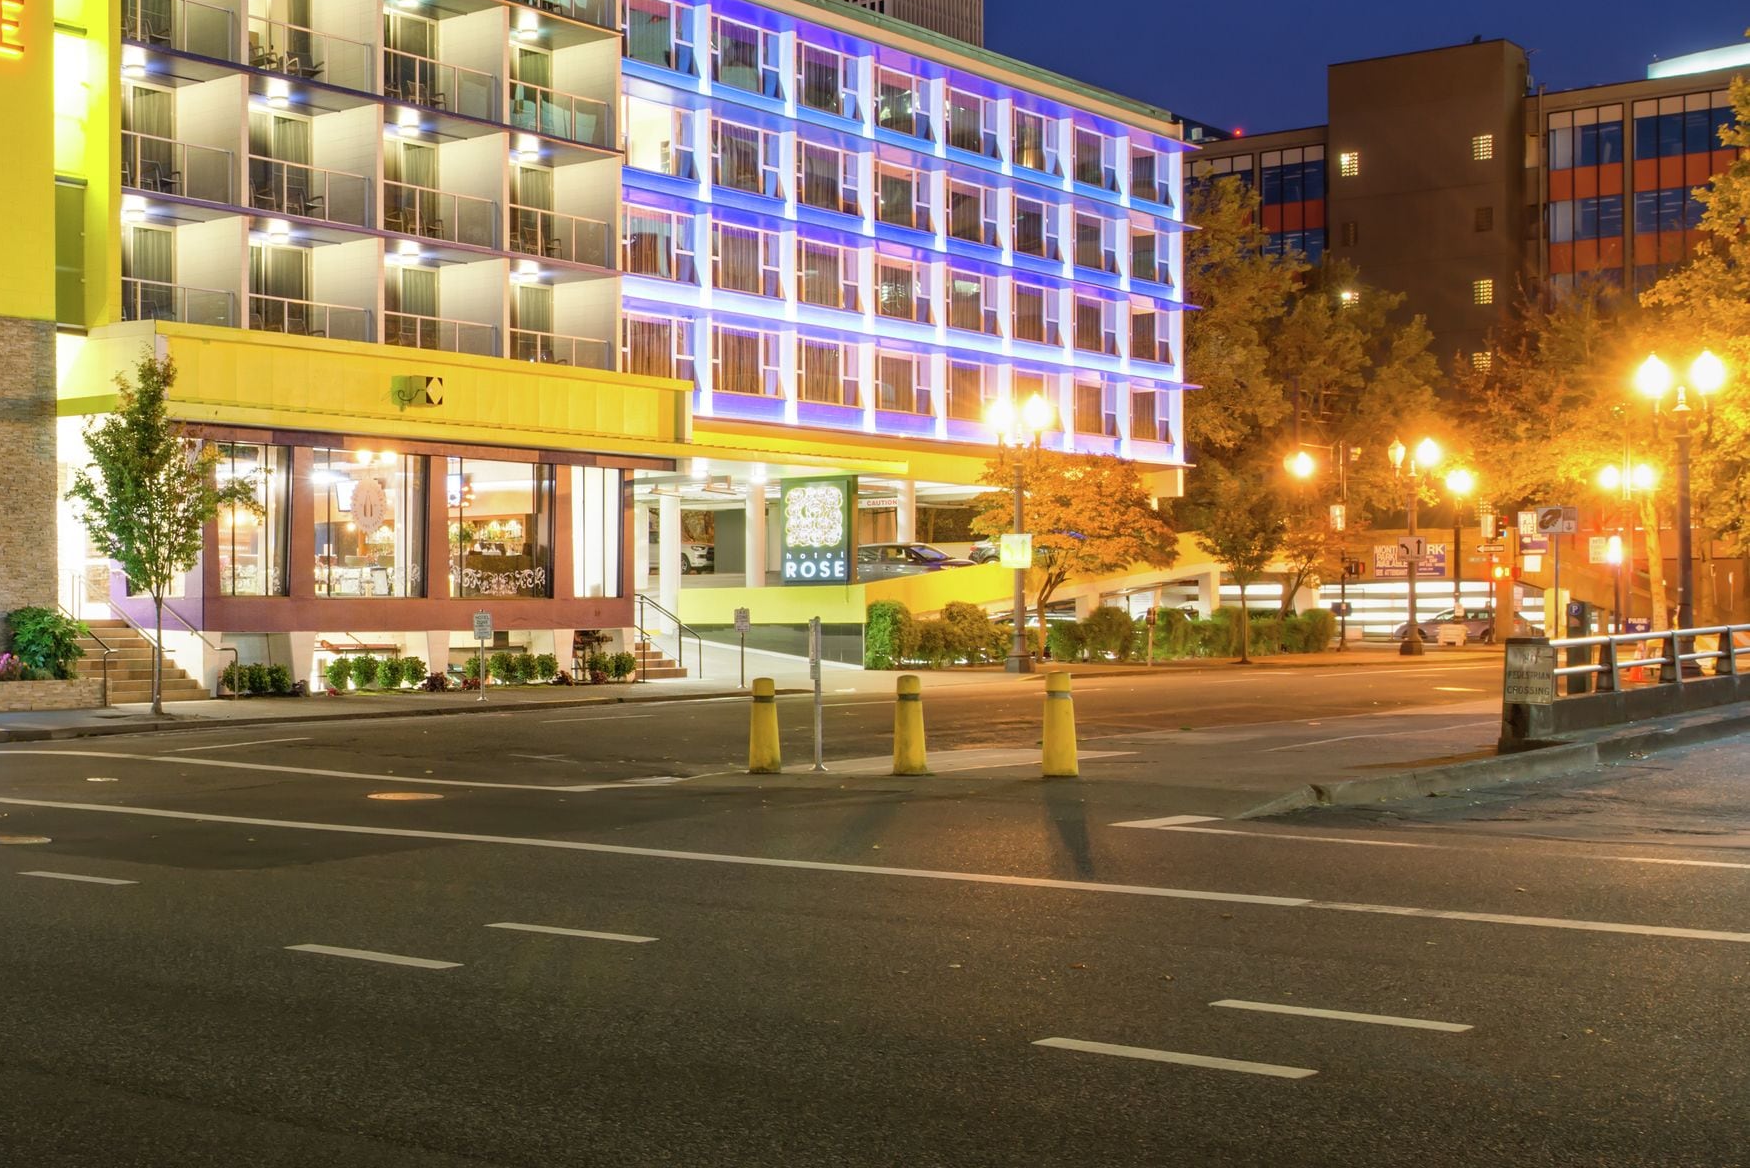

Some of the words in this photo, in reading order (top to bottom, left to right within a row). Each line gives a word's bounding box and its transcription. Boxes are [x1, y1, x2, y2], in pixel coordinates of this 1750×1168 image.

[786, 551, 844, 560] hotel
[785, 560, 845, 578] ROSE
[1508, 670, 1551, 680] PEDESTRIAN
[1506, 685, 1550, 696] CROSSING
